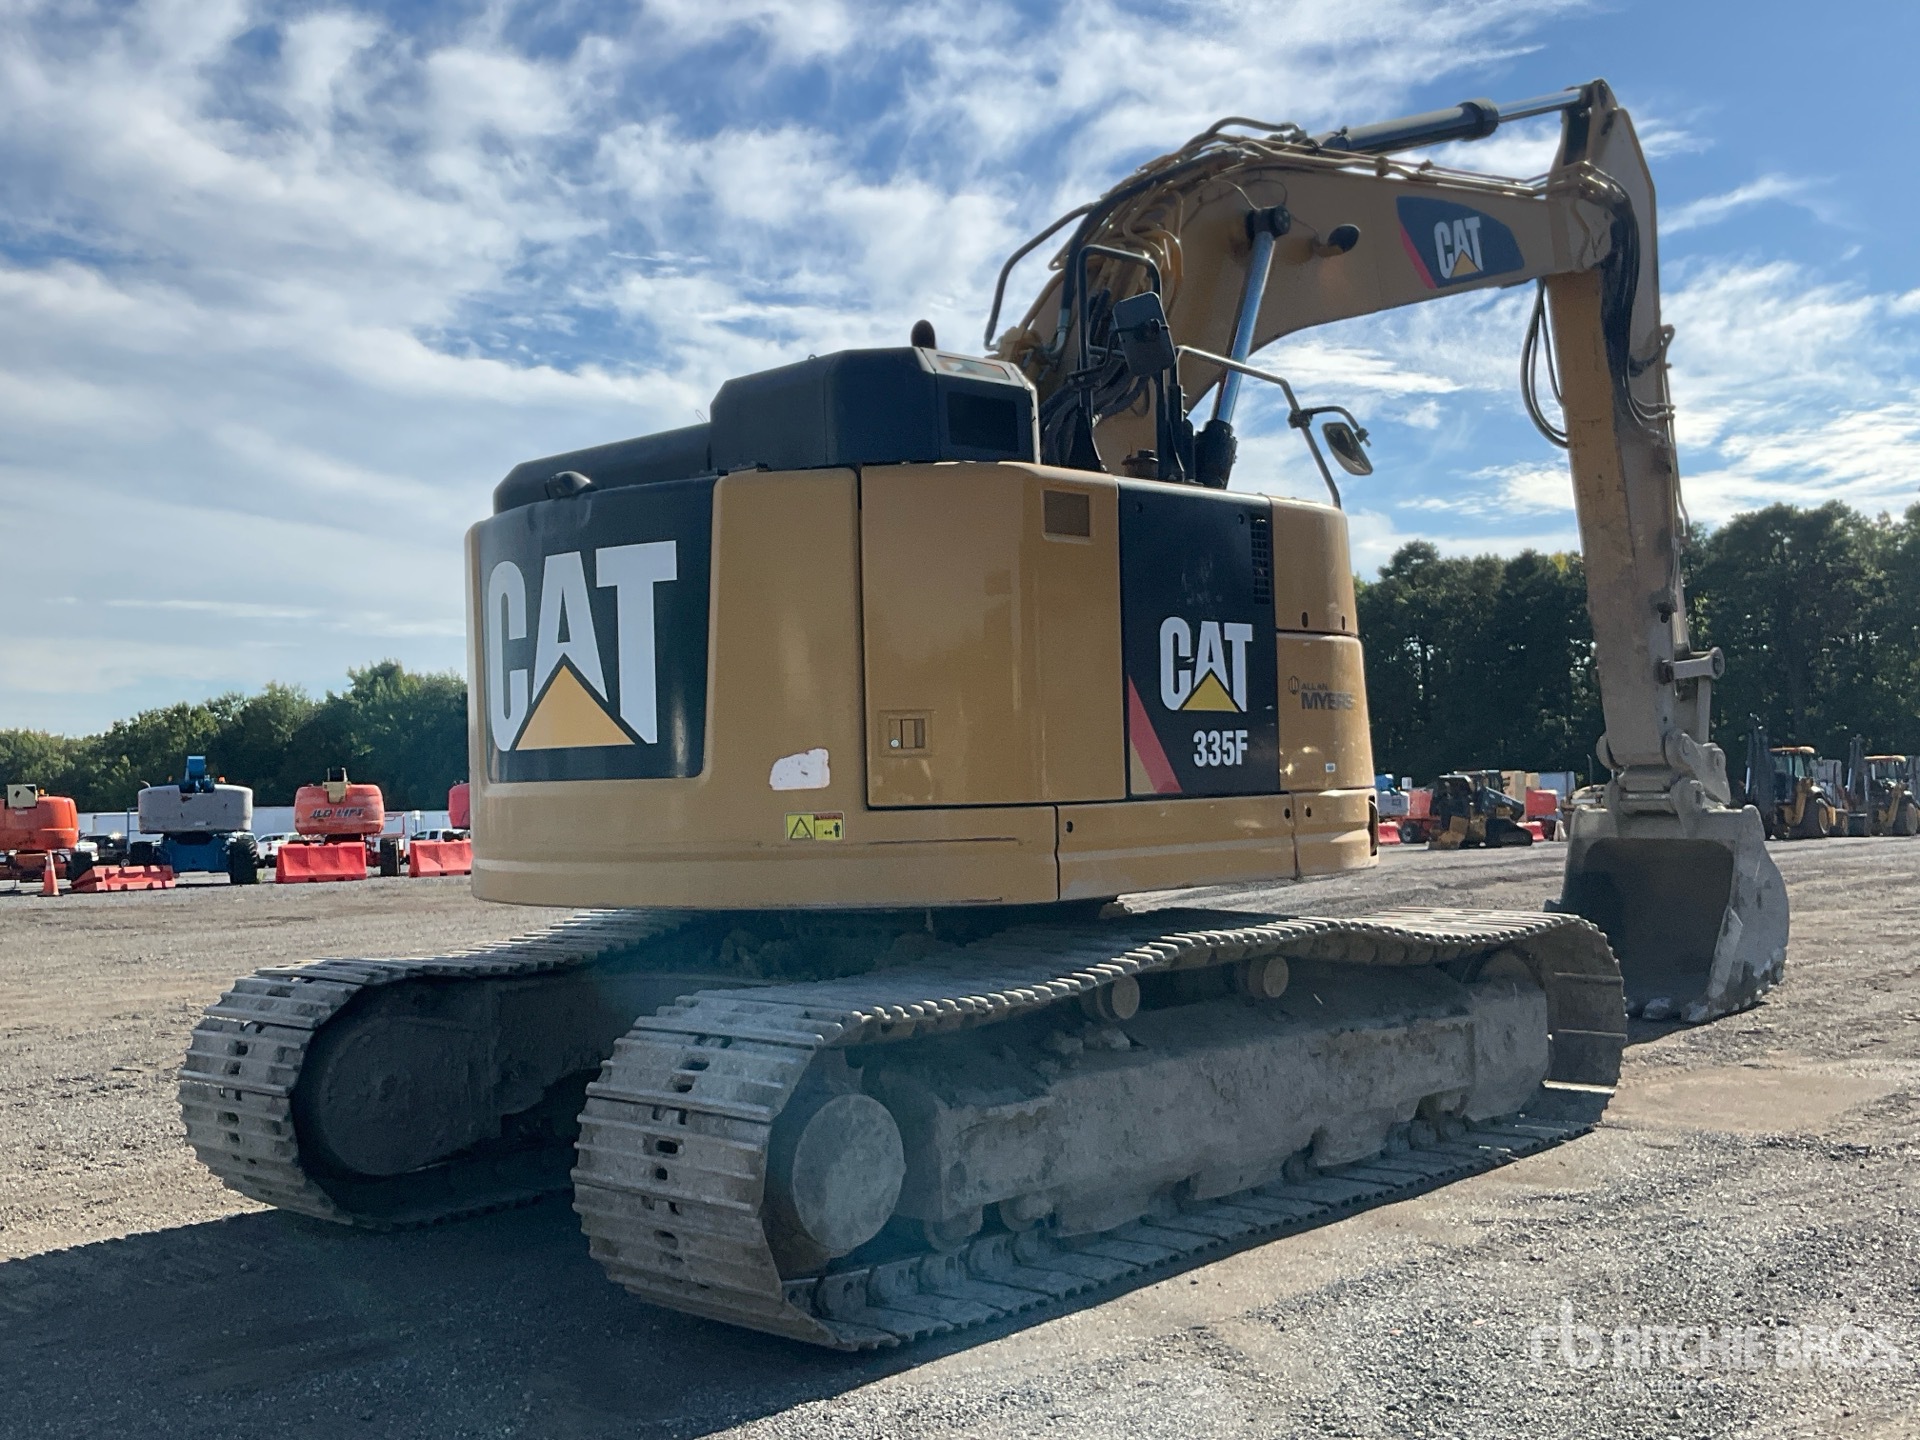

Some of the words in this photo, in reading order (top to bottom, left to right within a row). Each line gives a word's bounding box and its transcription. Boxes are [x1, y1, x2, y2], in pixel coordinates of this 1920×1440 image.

[1434, 216, 1483, 279] CAT
[488, 540, 677, 751] CAT
[1159, 616, 1253, 712] CAT
[1301, 692, 1354, 710] MYERS
[1193, 730, 1248, 767] 335F
